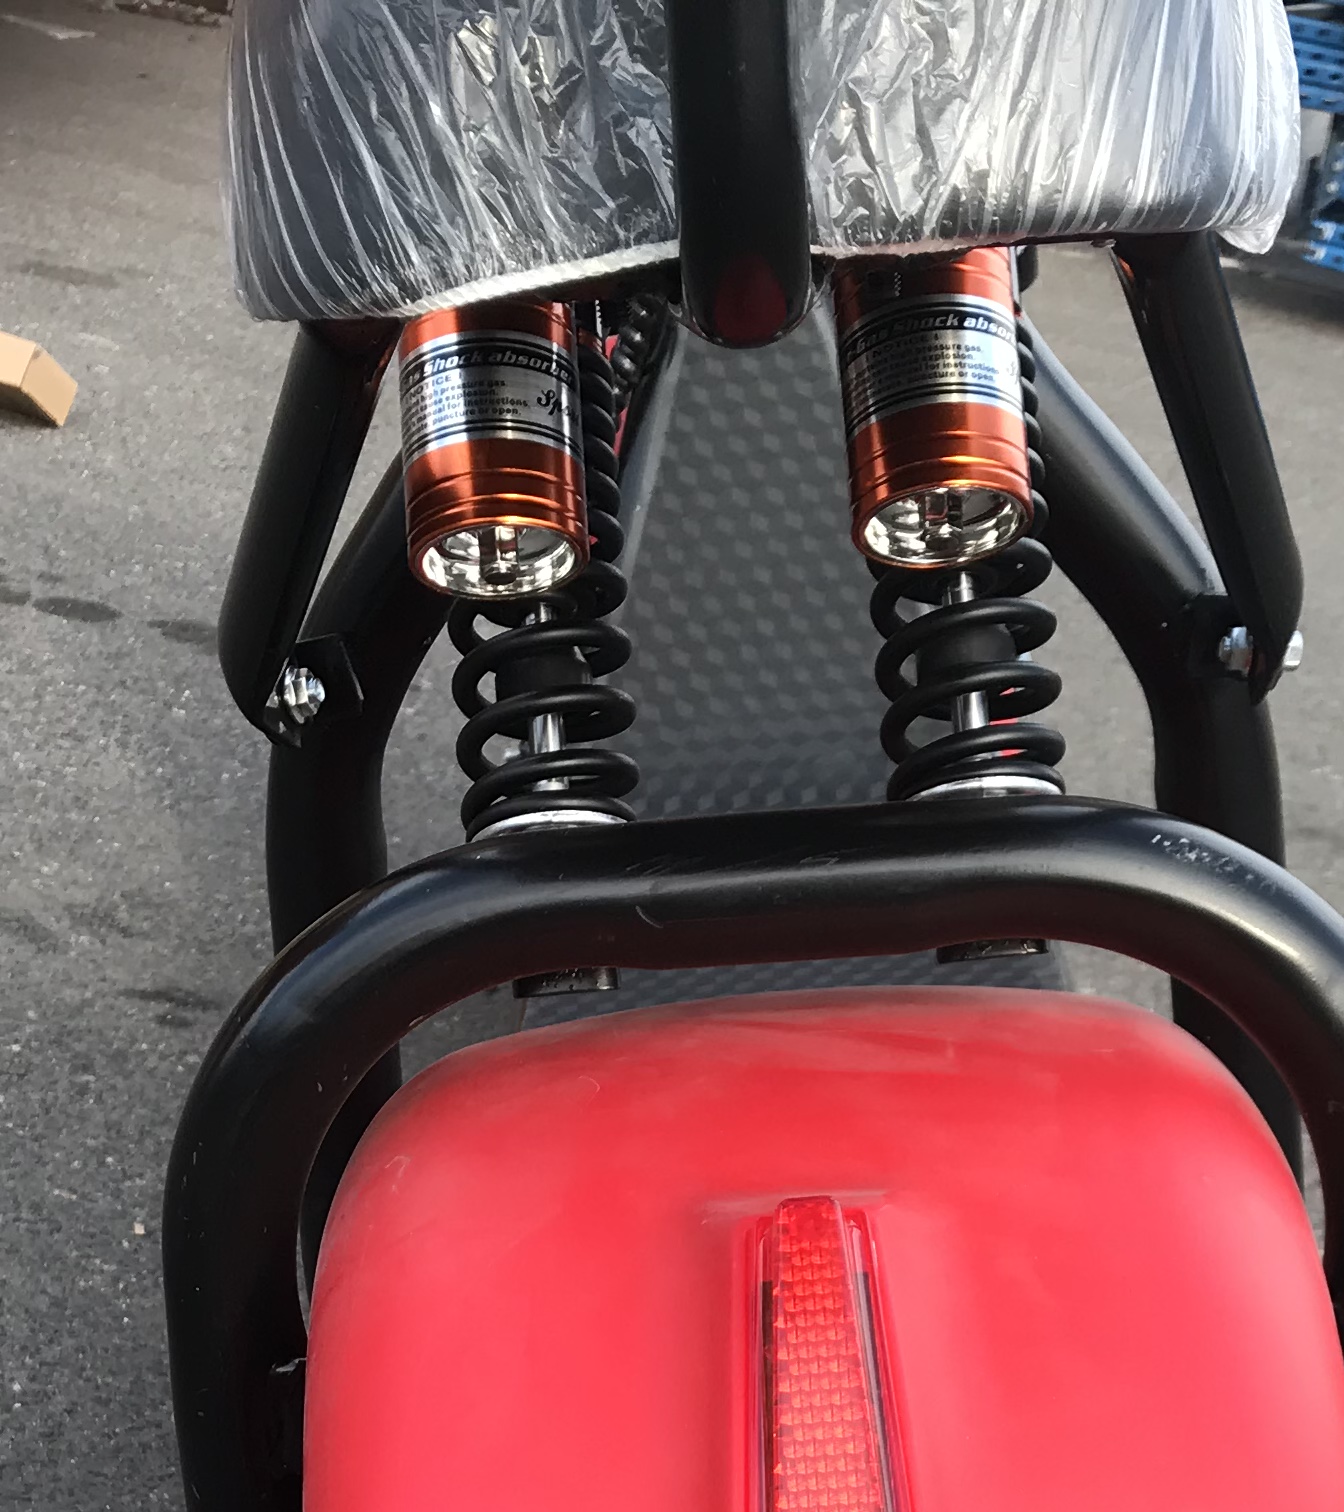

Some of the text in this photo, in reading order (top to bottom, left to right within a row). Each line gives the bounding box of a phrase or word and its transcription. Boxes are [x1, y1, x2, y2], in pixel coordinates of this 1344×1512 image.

[893, 313, 959, 334] Shock
[423, 350, 484, 377] Shock
[958, 370, 969, 378] or
[410, 374, 453, 402] NOTICE
[440, 379, 485, 397] pressure
[447, 401, 461, 411] for
[432, 408, 476, 426] puncture
